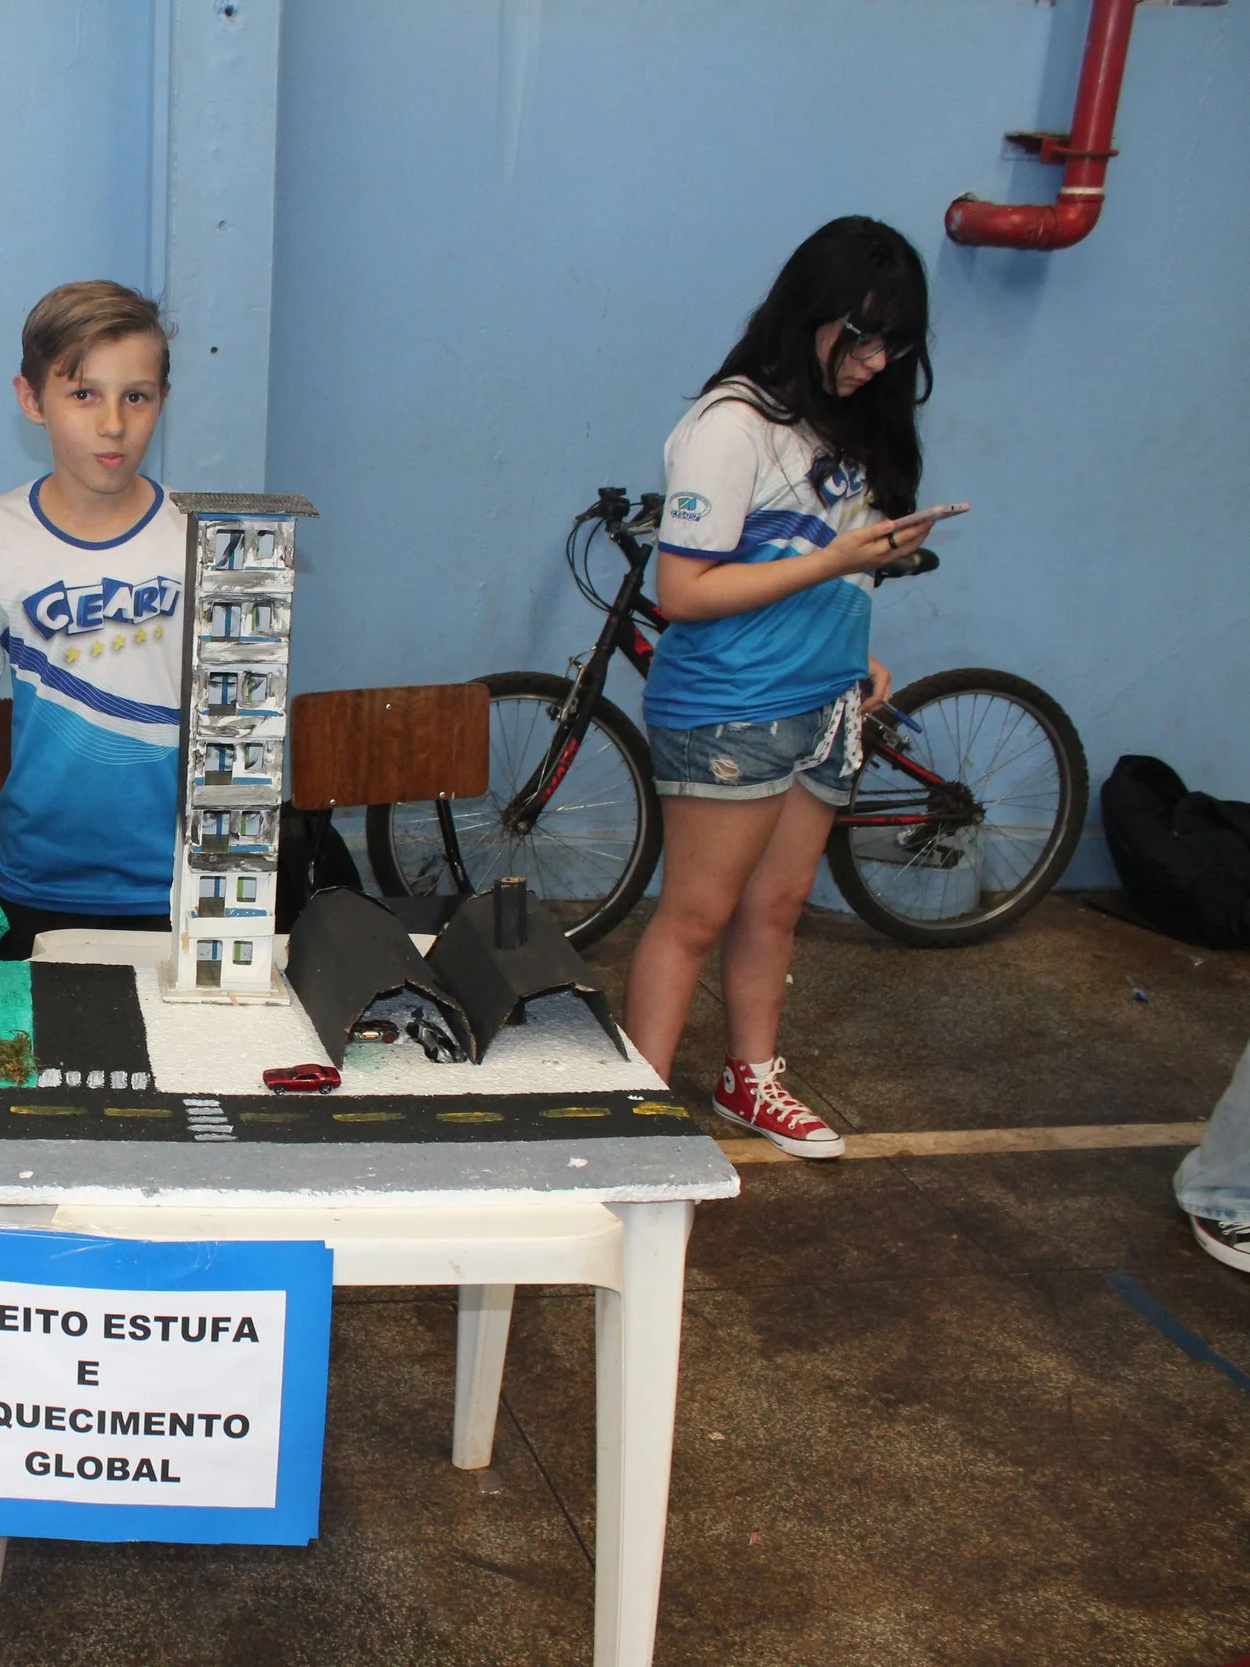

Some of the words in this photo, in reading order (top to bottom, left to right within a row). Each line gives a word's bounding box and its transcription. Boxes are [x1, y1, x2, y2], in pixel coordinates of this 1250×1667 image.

[26, 577, 183, 638] CEART
[104, 1313, 259, 1343] ESTUFA
[77, 1360, 99, 1386] E
[25, 1451, 181, 1483] GLOBAL
